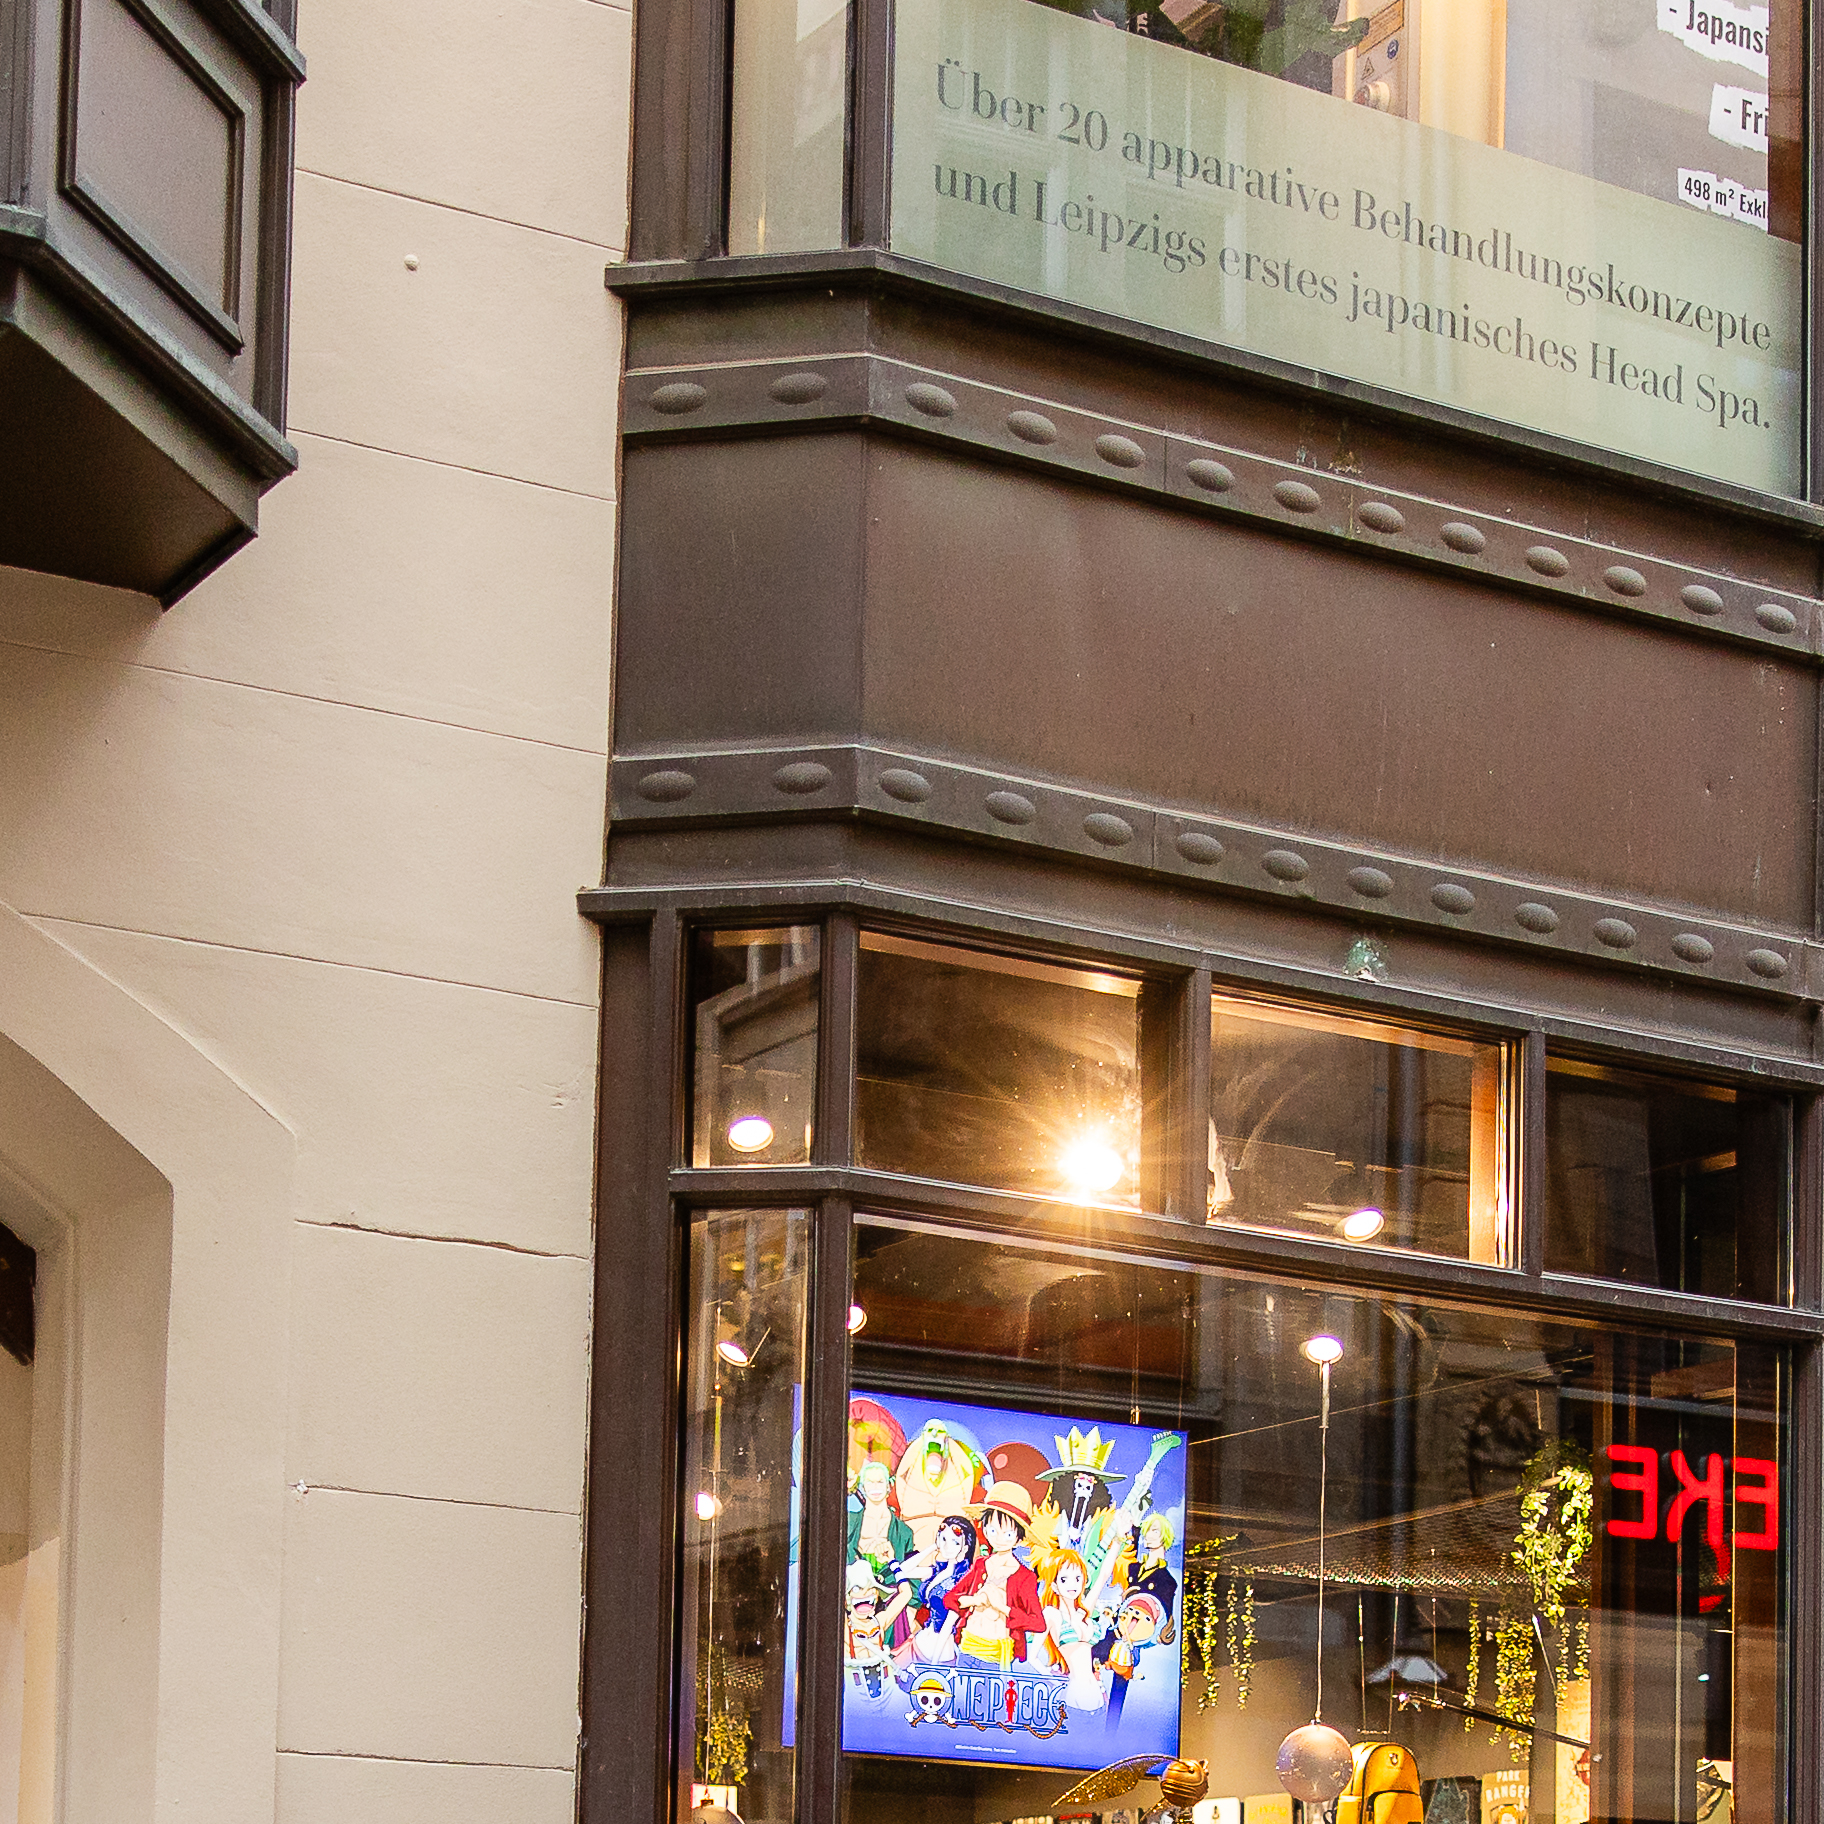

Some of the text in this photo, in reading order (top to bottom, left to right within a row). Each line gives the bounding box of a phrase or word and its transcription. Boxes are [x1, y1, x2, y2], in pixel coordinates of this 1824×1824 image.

[936, 57, 1772, 351] Über 20 apparative Behandlungskonzepte
[1684, 176, 1711, 201] 498
[1739, 194, 1769, 219] Exkl
[932, 163, 1772, 431] und Leipzigs erstes japanisches Head Spa.
[1496, 1770, 1521, 1782] PARK
